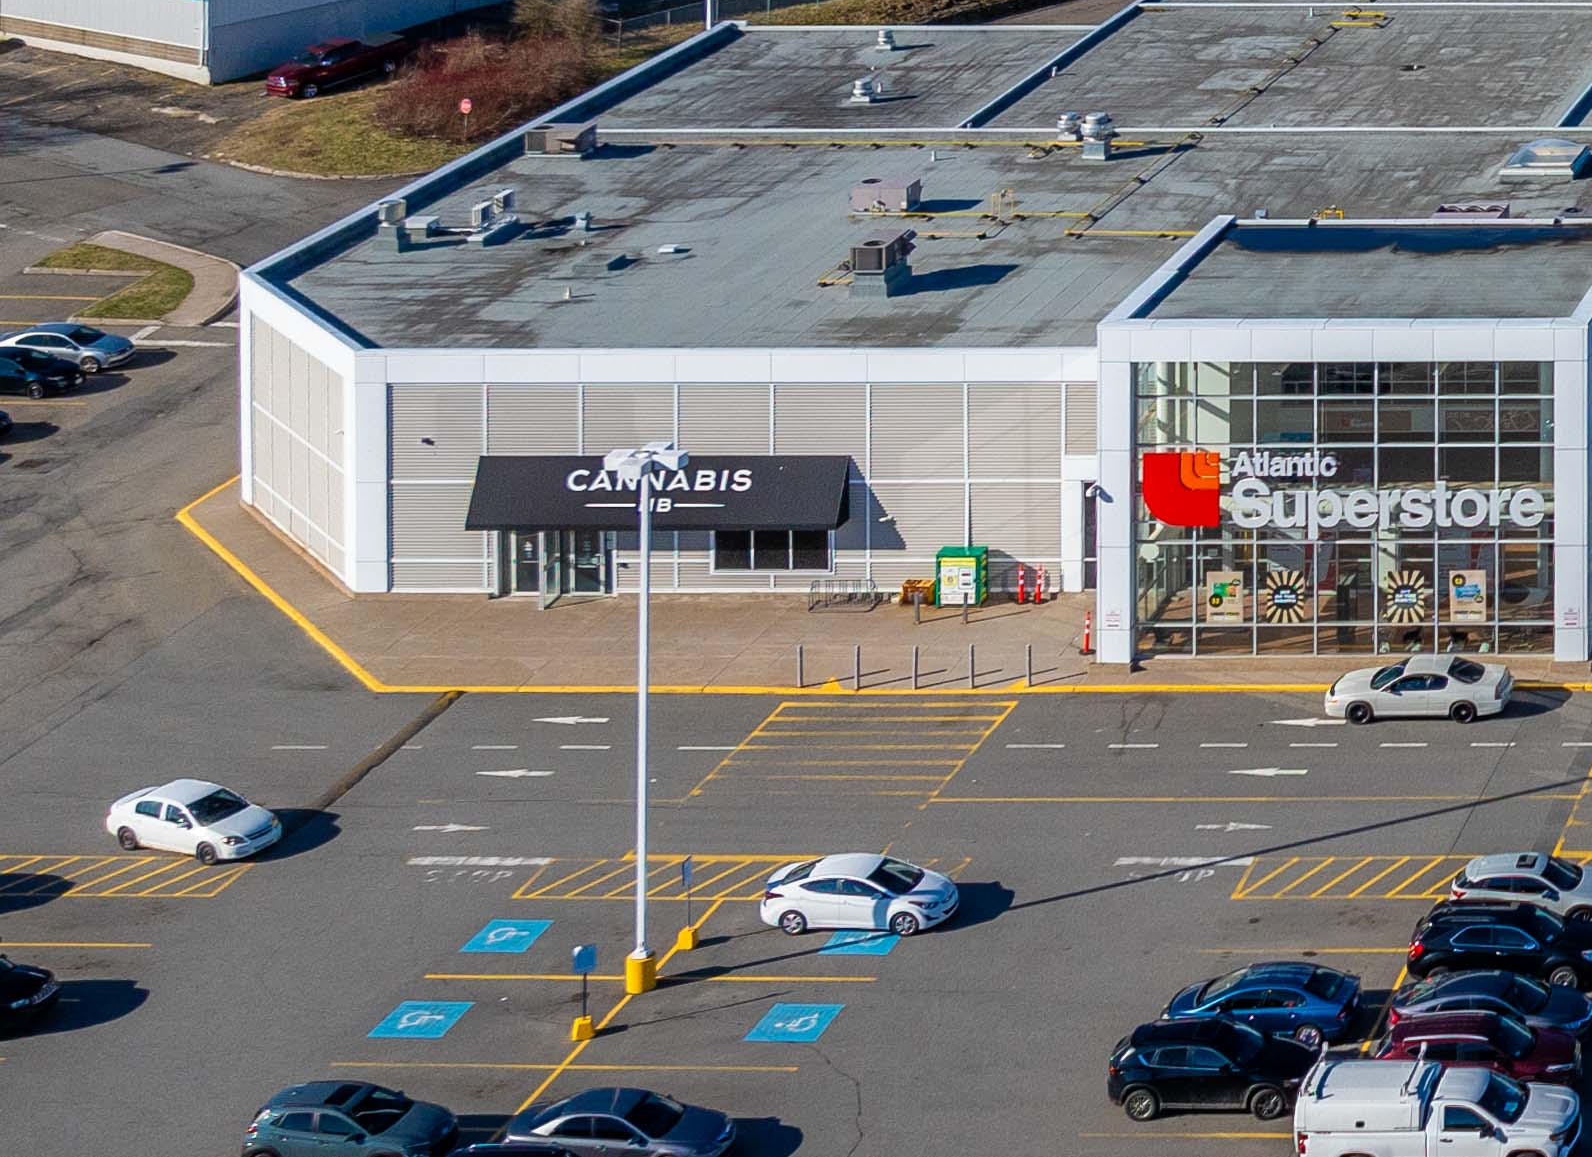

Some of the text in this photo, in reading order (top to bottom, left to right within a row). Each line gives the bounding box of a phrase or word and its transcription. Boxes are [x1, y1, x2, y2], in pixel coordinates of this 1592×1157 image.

[1231, 451, 1338, 477] Atlantic
[566, 469, 753, 492] CANNABIS
[1231, 477, 1545, 540] Superstore
